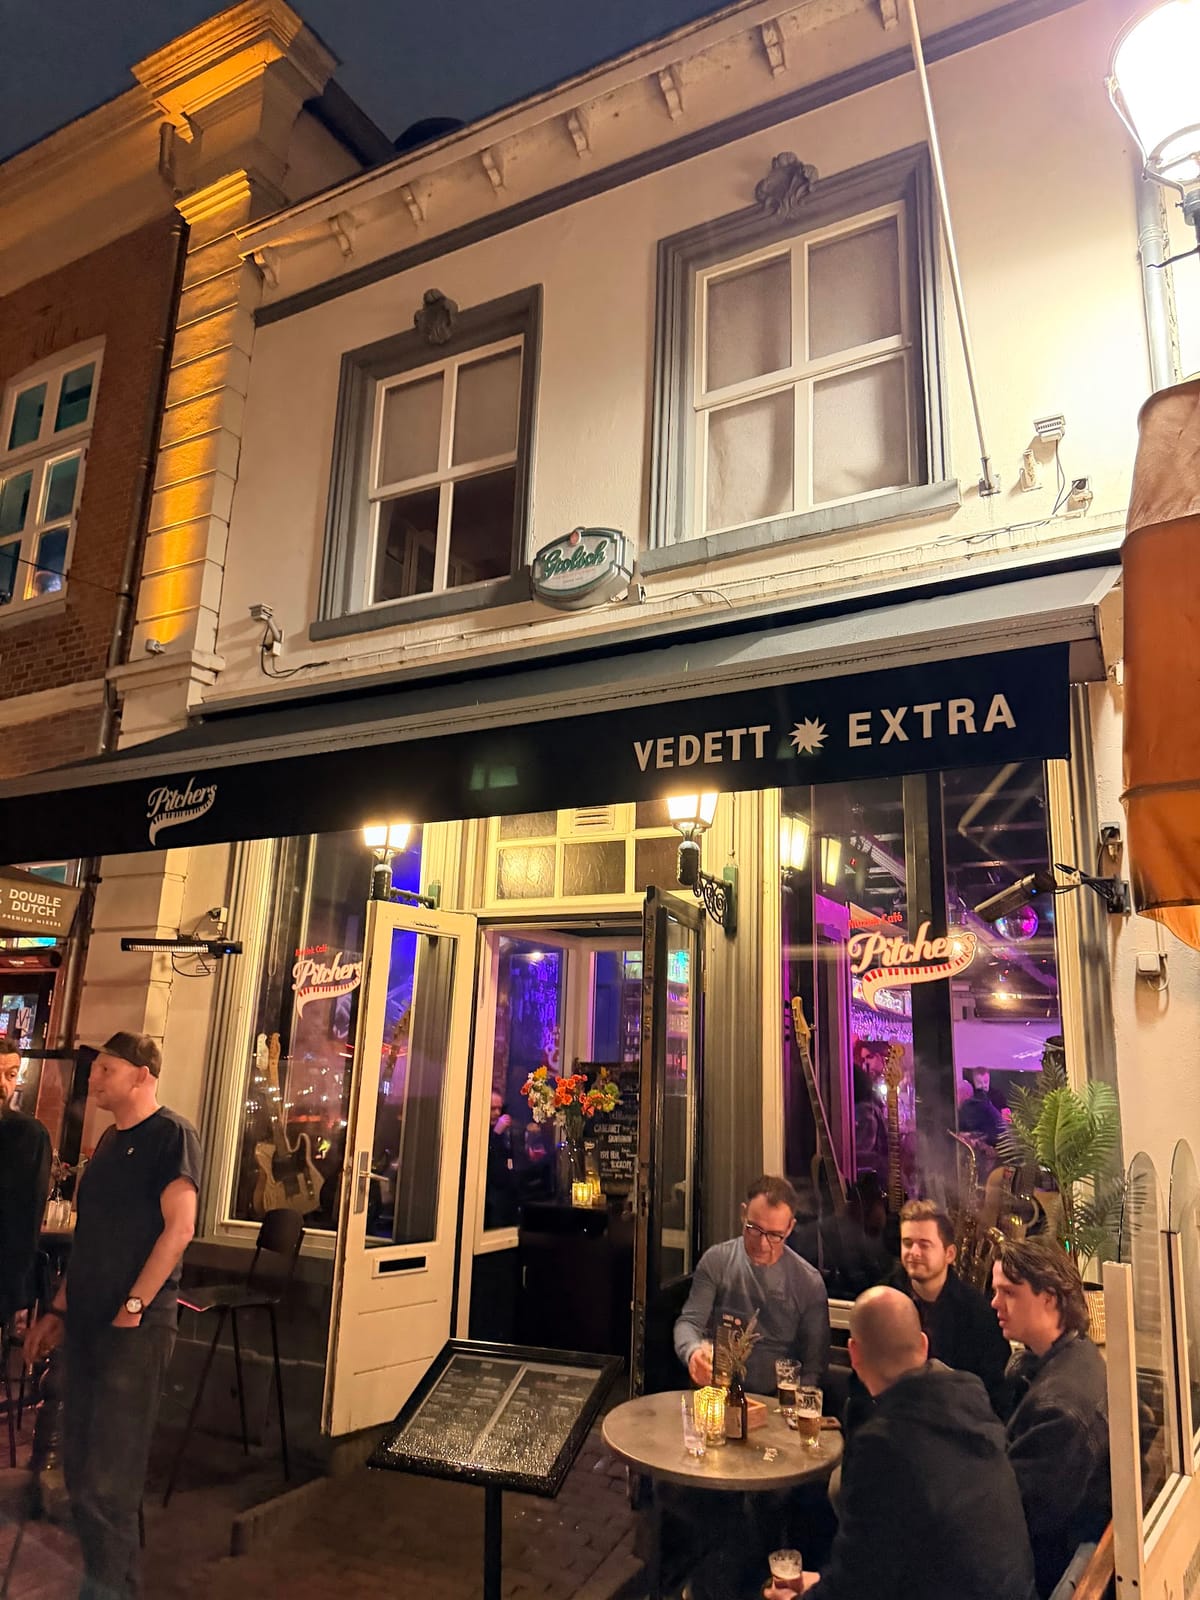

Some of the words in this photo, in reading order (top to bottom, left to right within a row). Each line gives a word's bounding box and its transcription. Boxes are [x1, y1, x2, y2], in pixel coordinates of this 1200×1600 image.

[543, 540, 608, 579] Grolsch
[633, 725, 770, 771] VEDETT
[848, 694, 1016, 747] EXTRA
[146, 776, 217, 818] Pitchers
[9, 888, 61, 907] DOUBLE
[12, 900, 56, 917] DUTCH
[848, 921, 977, 973] Pitchers
